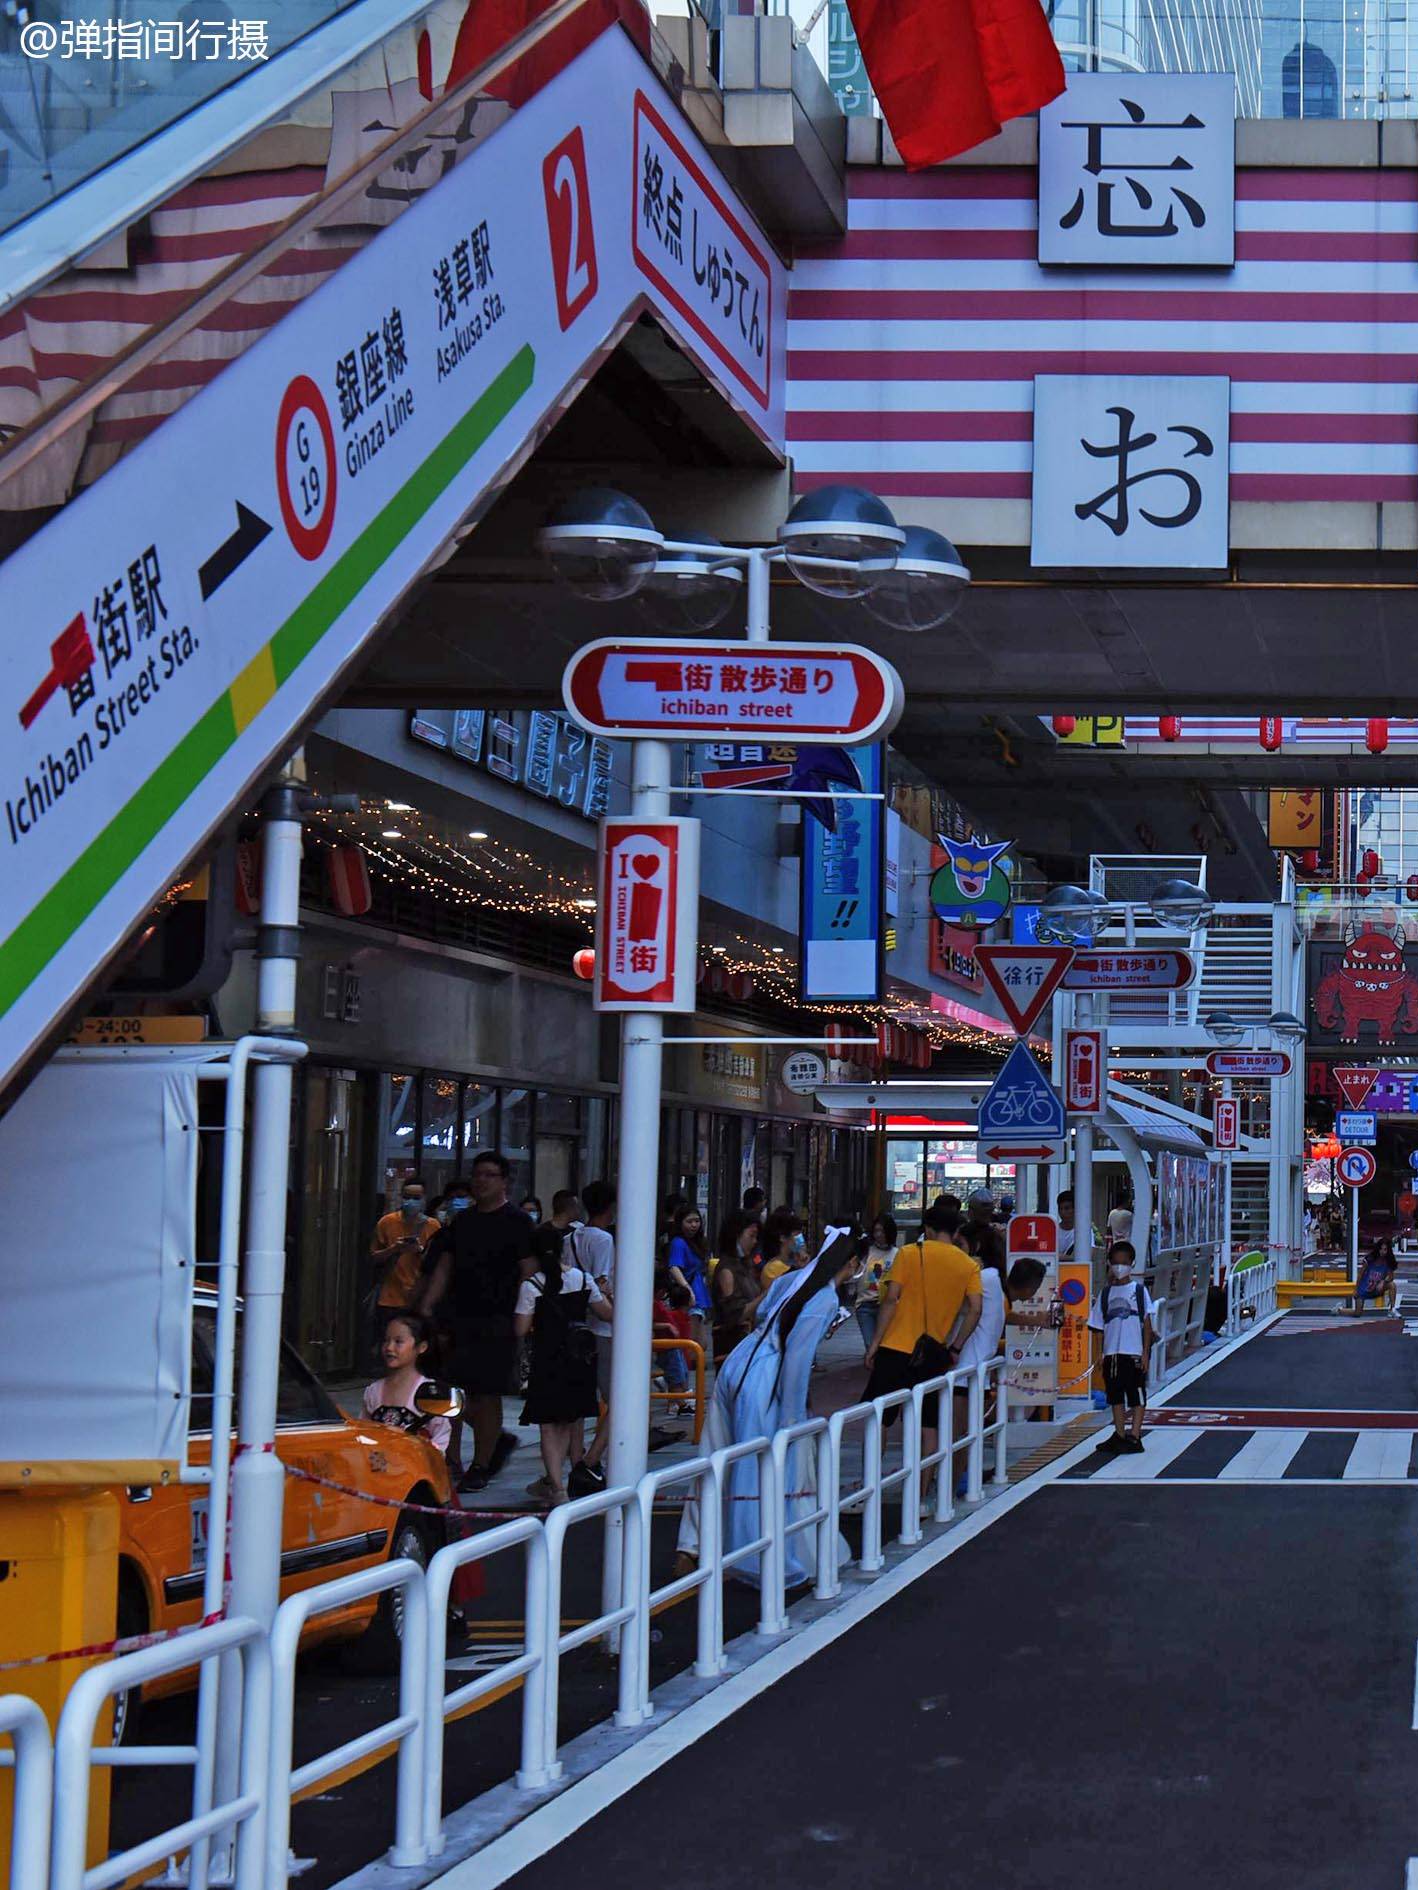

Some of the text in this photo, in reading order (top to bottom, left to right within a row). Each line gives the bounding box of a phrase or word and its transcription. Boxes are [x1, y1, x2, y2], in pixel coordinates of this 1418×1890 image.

[554, 155, 588, 291] 2
[642, 143, 766, 360] 終点 しゅうてん
[431, 220, 495, 333] 浅草駅
[436, 303, 507, 384] Asakusa Sta.
[335, 306, 409, 433] 銀座線
[296, 421, 311, 462] G
[345, 391, 415, 478] Ginza Line
[298, 469, 322, 521] 19
[720, 663, 834, 695] 散歩通り
[661, 698, 794, 718] ichiban street
[5, 629, 201, 845] Ichiban Street Sta.
[618, 853, 629, 879] I
[615, 886, 627, 974] ICHIBAN STREET
[630, 946, 657, 974] 街
[1004, 966, 1045, 986] 徐行
[1090, 973, 1151, 983] ichiban street
[1116, 957, 1168, 973] 散歩通り
[1342, 1074, 1370, 1085] 止まれ
[1026, 1221, 1039, 1240] 1
